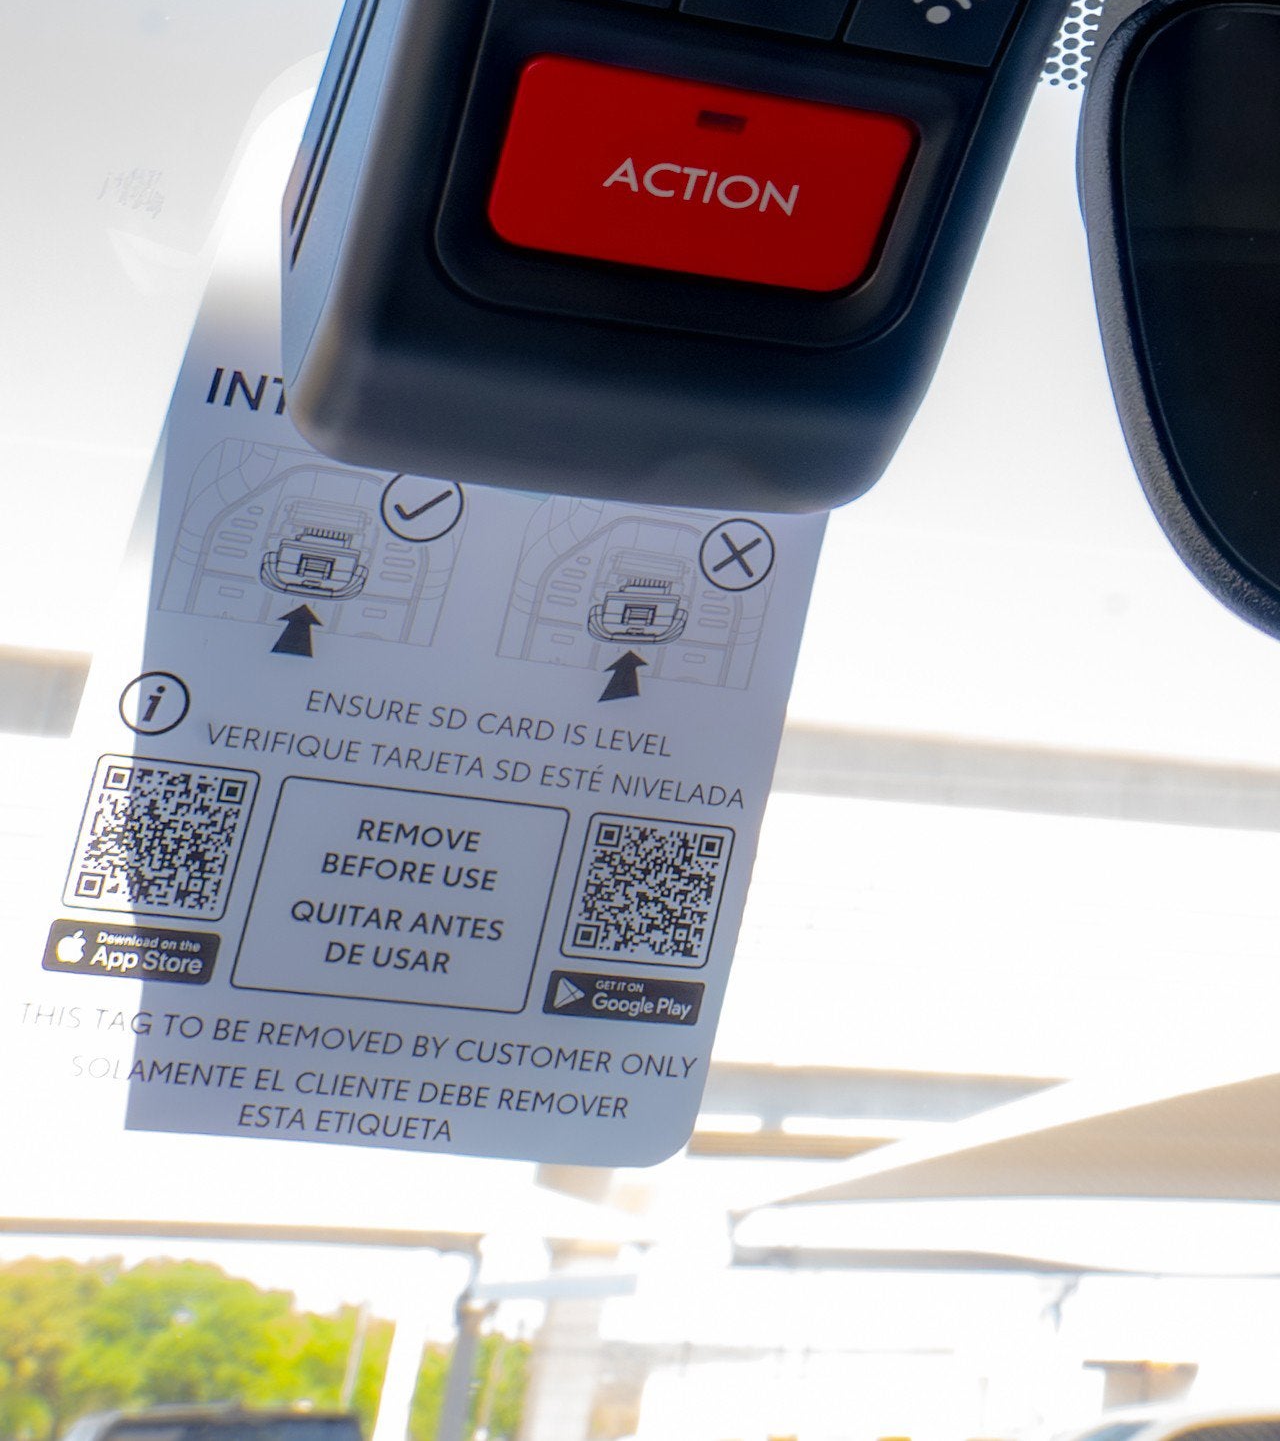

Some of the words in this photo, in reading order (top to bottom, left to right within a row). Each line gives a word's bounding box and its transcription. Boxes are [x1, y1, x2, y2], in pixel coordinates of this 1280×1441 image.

[602, 157, 799, 217] ACTION
[305, 689, 422, 726] ENSURE
[428, 706, 468, 731] SD
[476, 712, 555, 742] CARD
[562, 723, 588, 746] IS
[595, 728, 672, 757] LEVEL
[206, 722, 362, 764] VERIFIQUE
[371, 743, 485, 779] TARJETA
[492, 759, 532, 783] SD
[540, 764, 605, 793] ESTÉ
[611, 773, 745, 810] NIVELADA
[356, 819, 482, 853] REMOVE
[320, 852, 436, 884] BEFORE
[442, 864, 498, 892] USE
[291, 900, 403, 931] QUITAR
[408, 912, 505, 942] ANTES
[89, 945, 140, 973] App
[142, 949, 203, 975] Store
[96, 931, 160, 949] Download
[160, 939, 177, 951] on
[179, 939, 202, 953] the
[324, 941, 366, 966] DE
[372, 945, 451, 974] USAR
[595, 980, 615, 990] GET
[616, 982, 626, 991] IT
[626, 982, 644, 992] ON
[592, 992, 654, 1017] Google
[655, 998, 692, 1021] Play
[21, 1002, 81, 1030] THIS
[96, 1007, 153, 1037] TAG
[164, 1014, 203, 1038] TO
[213, 1019, 250, 1042] BE
[257, 1022, 402, 1055] REMOVED
[411, 1035, 449, 1059] BY
[456, 1039, 612, 1073] CUSTOMER
[621, 1054, 698, 1079] ONLY
[72, 1055, 247, 1089] SOLAMENTE
[254, 1069, 285, 1091] EL
[295, 1072, 411, 1101] CLIENTE
[418, 1082, 490, 1108] DEBE
[497, 1088, 629, 1119] REMOVER
[237, 1104, 305, 1130] ESTA
[315, 1109, 452, 1142] ETIQUETA
